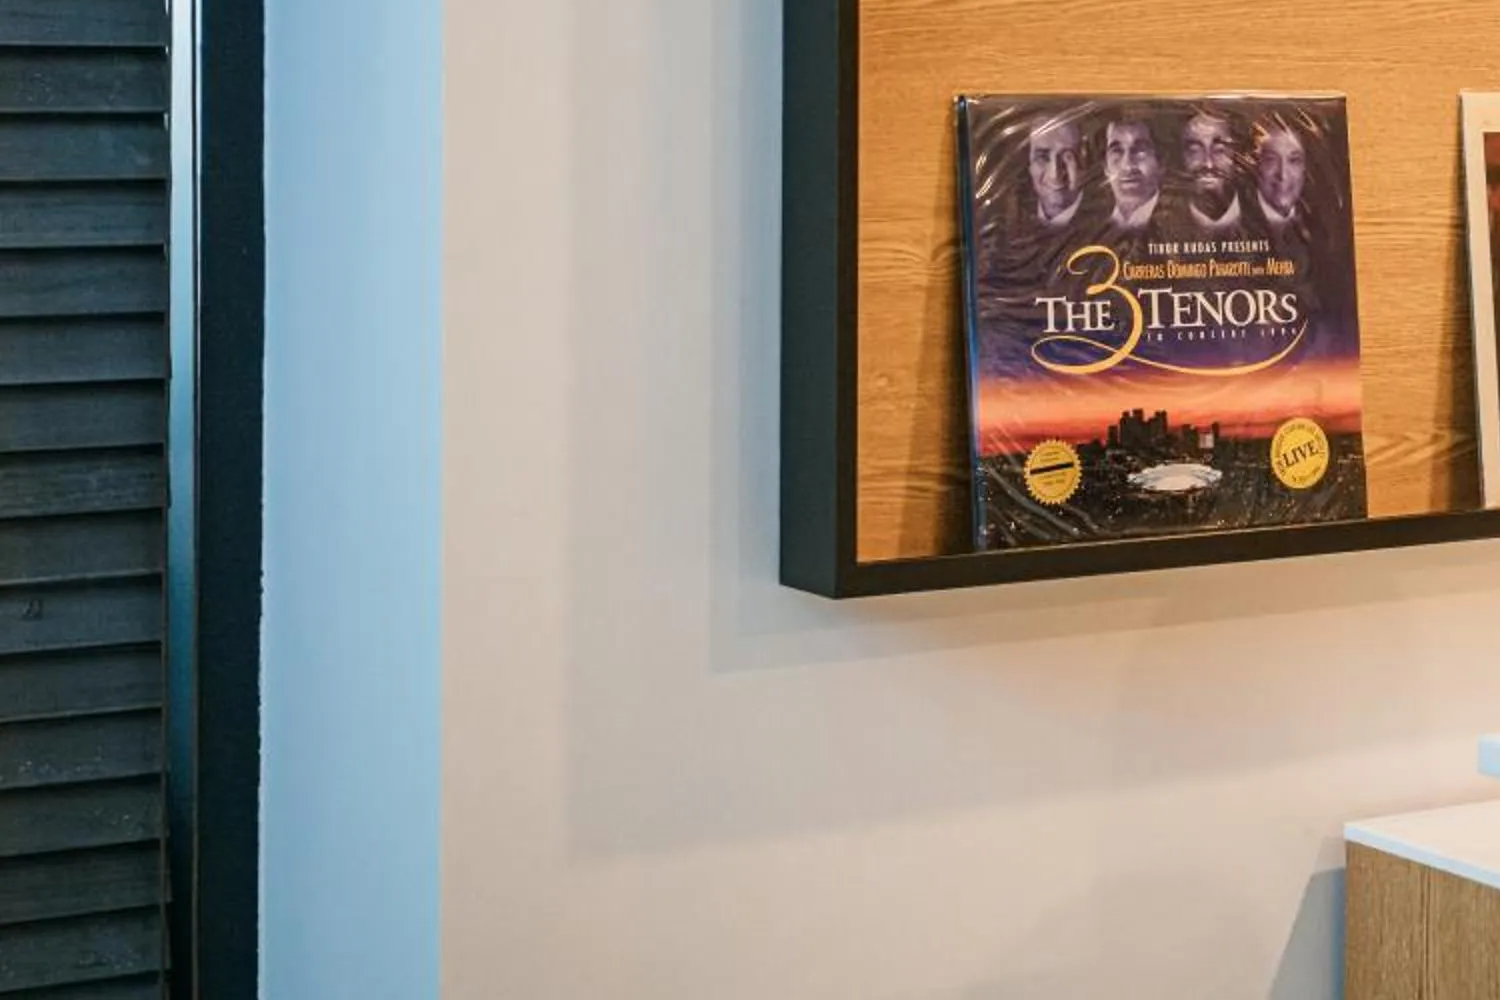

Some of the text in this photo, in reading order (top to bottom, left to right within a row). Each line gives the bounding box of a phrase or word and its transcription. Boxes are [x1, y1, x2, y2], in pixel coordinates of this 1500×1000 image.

[1221, 240, 1270, 253] PRESENTS
[1036, 296, 1117, 333] THE
[1138, 287, 1298, 330] TENORS
[1281, 440, 1320, 467] LIVE
